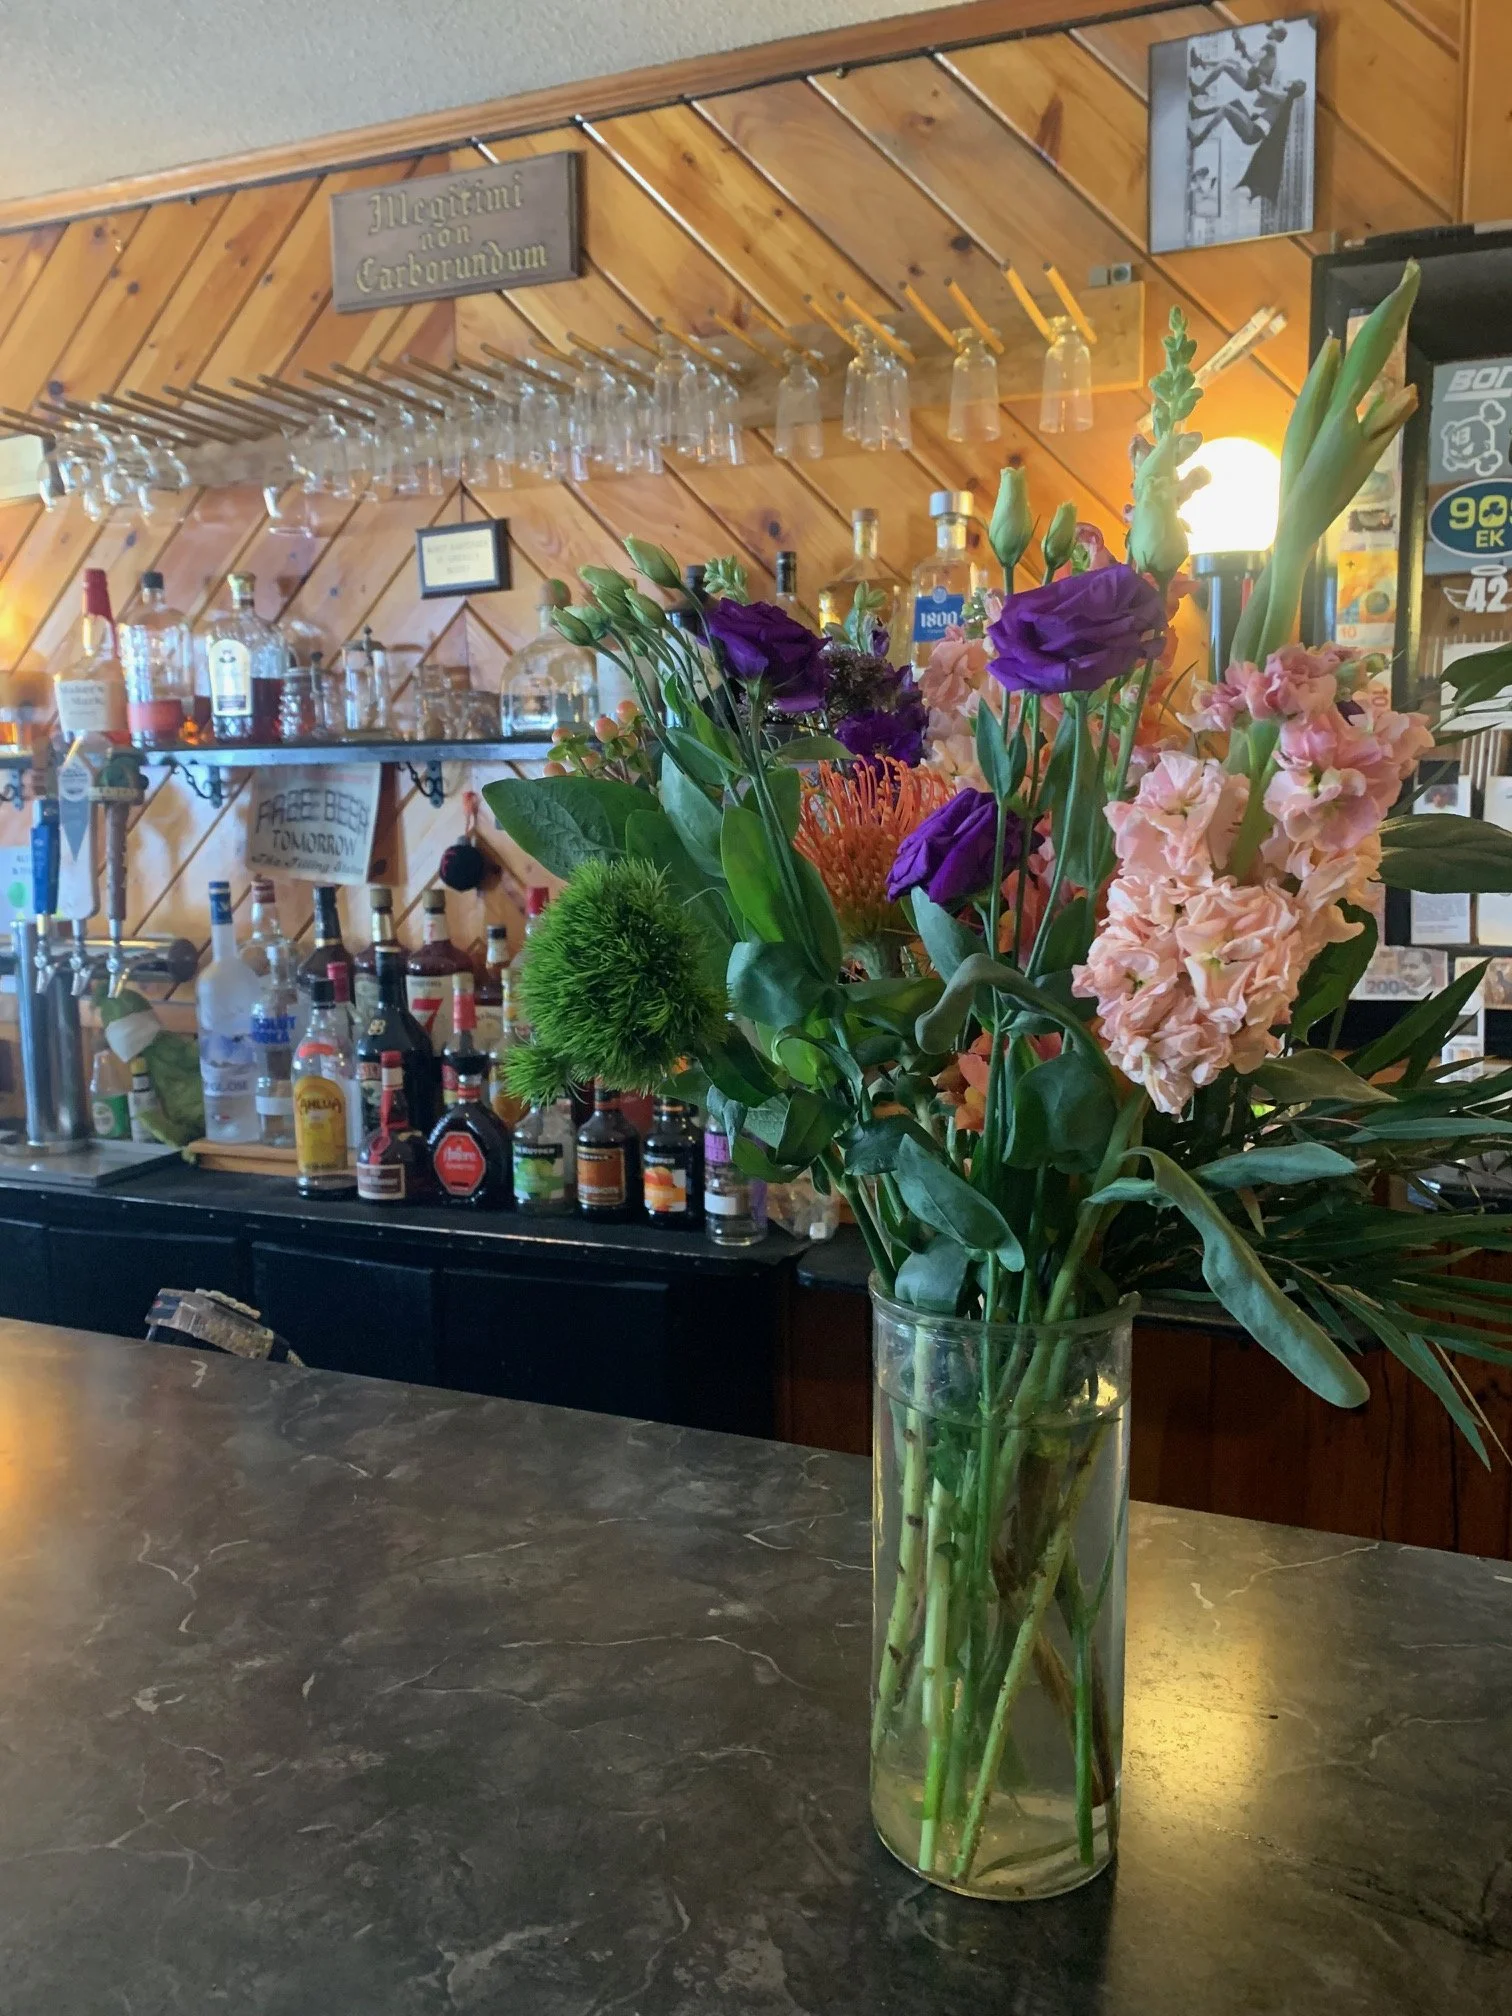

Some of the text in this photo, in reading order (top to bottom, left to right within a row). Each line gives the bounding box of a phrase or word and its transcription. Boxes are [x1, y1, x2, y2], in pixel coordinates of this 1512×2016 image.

[368, 171, 523, 235] Illegitimi
[420, 224, 472, 251] non
[355, 241, 549, 294] Carborundum
[1475, 529, 1505, 549] EK
[920, 610, 958, 628] 1800
[255, 788, 371, 845] FREE BEER
[272, 829, 357, 857] TOMORROW
[1366, 979, 1400, 994] 200
[411, 997, 444, 1034] 7
